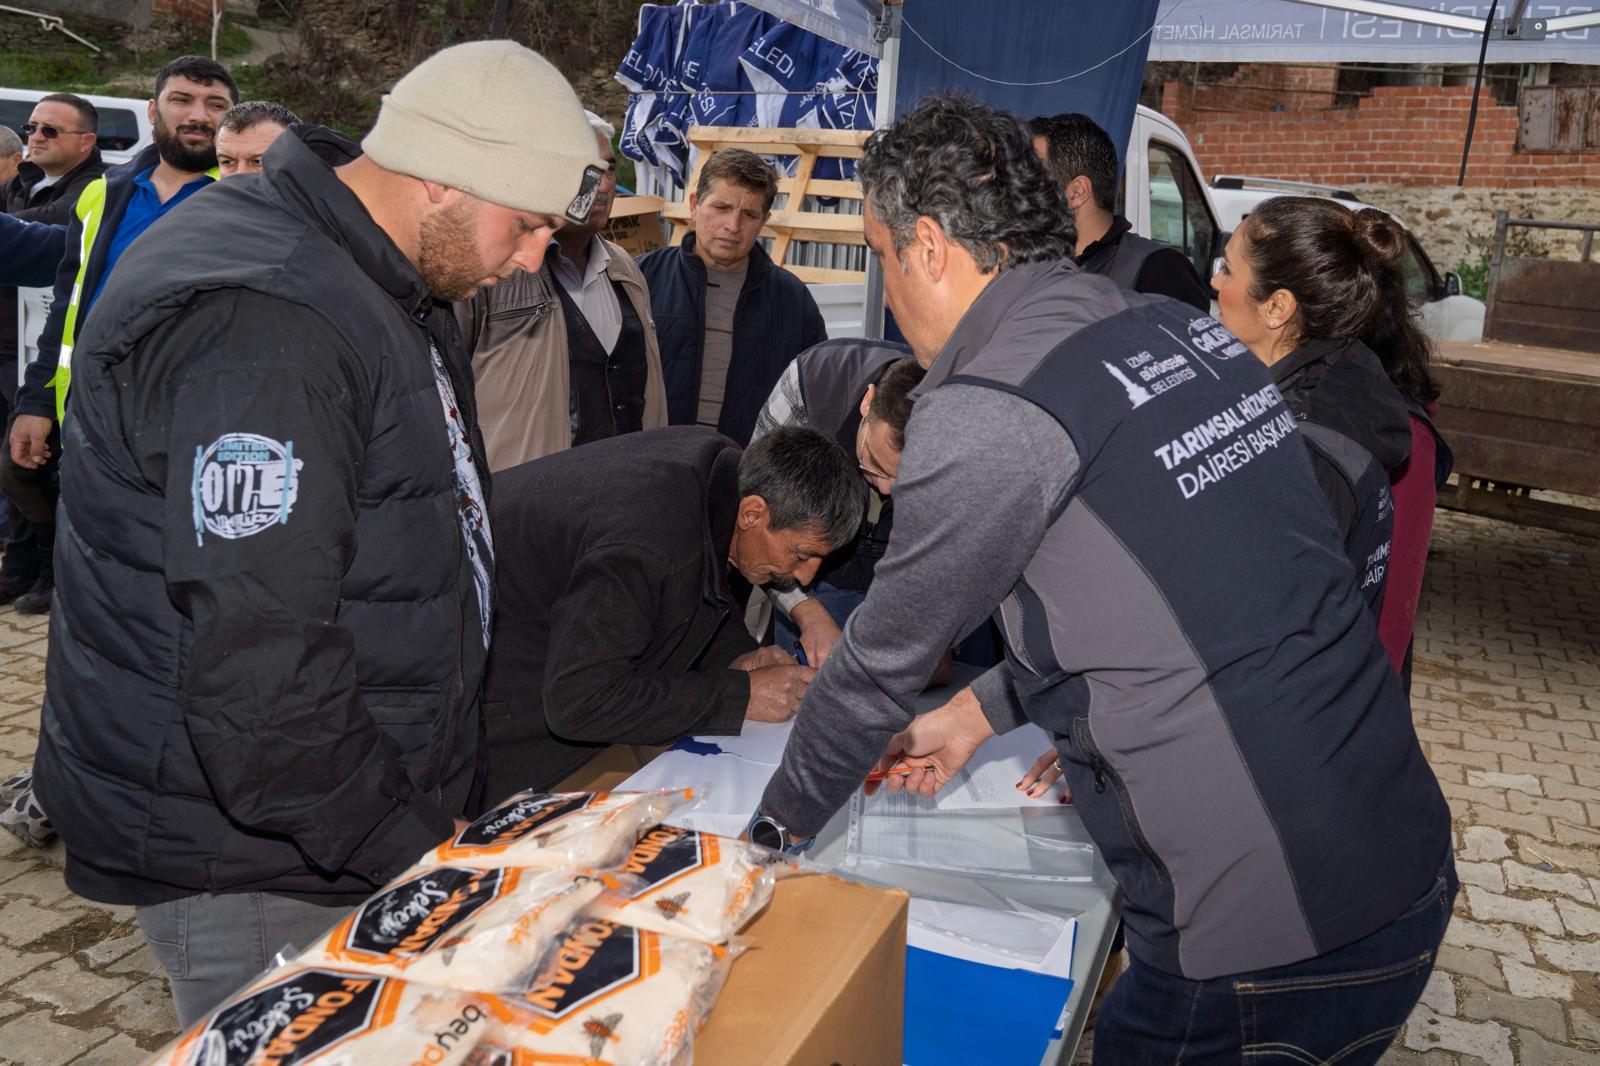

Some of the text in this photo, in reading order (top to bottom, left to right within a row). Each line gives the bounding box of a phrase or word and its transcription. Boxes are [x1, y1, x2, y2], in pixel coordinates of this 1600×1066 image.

[1154, 408, 1247, 470] TARIMSAL
[1176, 435, 1252, 499] DAİRESİ
[624, 825, 687, 874] ONDA
[258, 978, 373, 1066] FONDA
[411, 1003, 488, 1066] beyp
